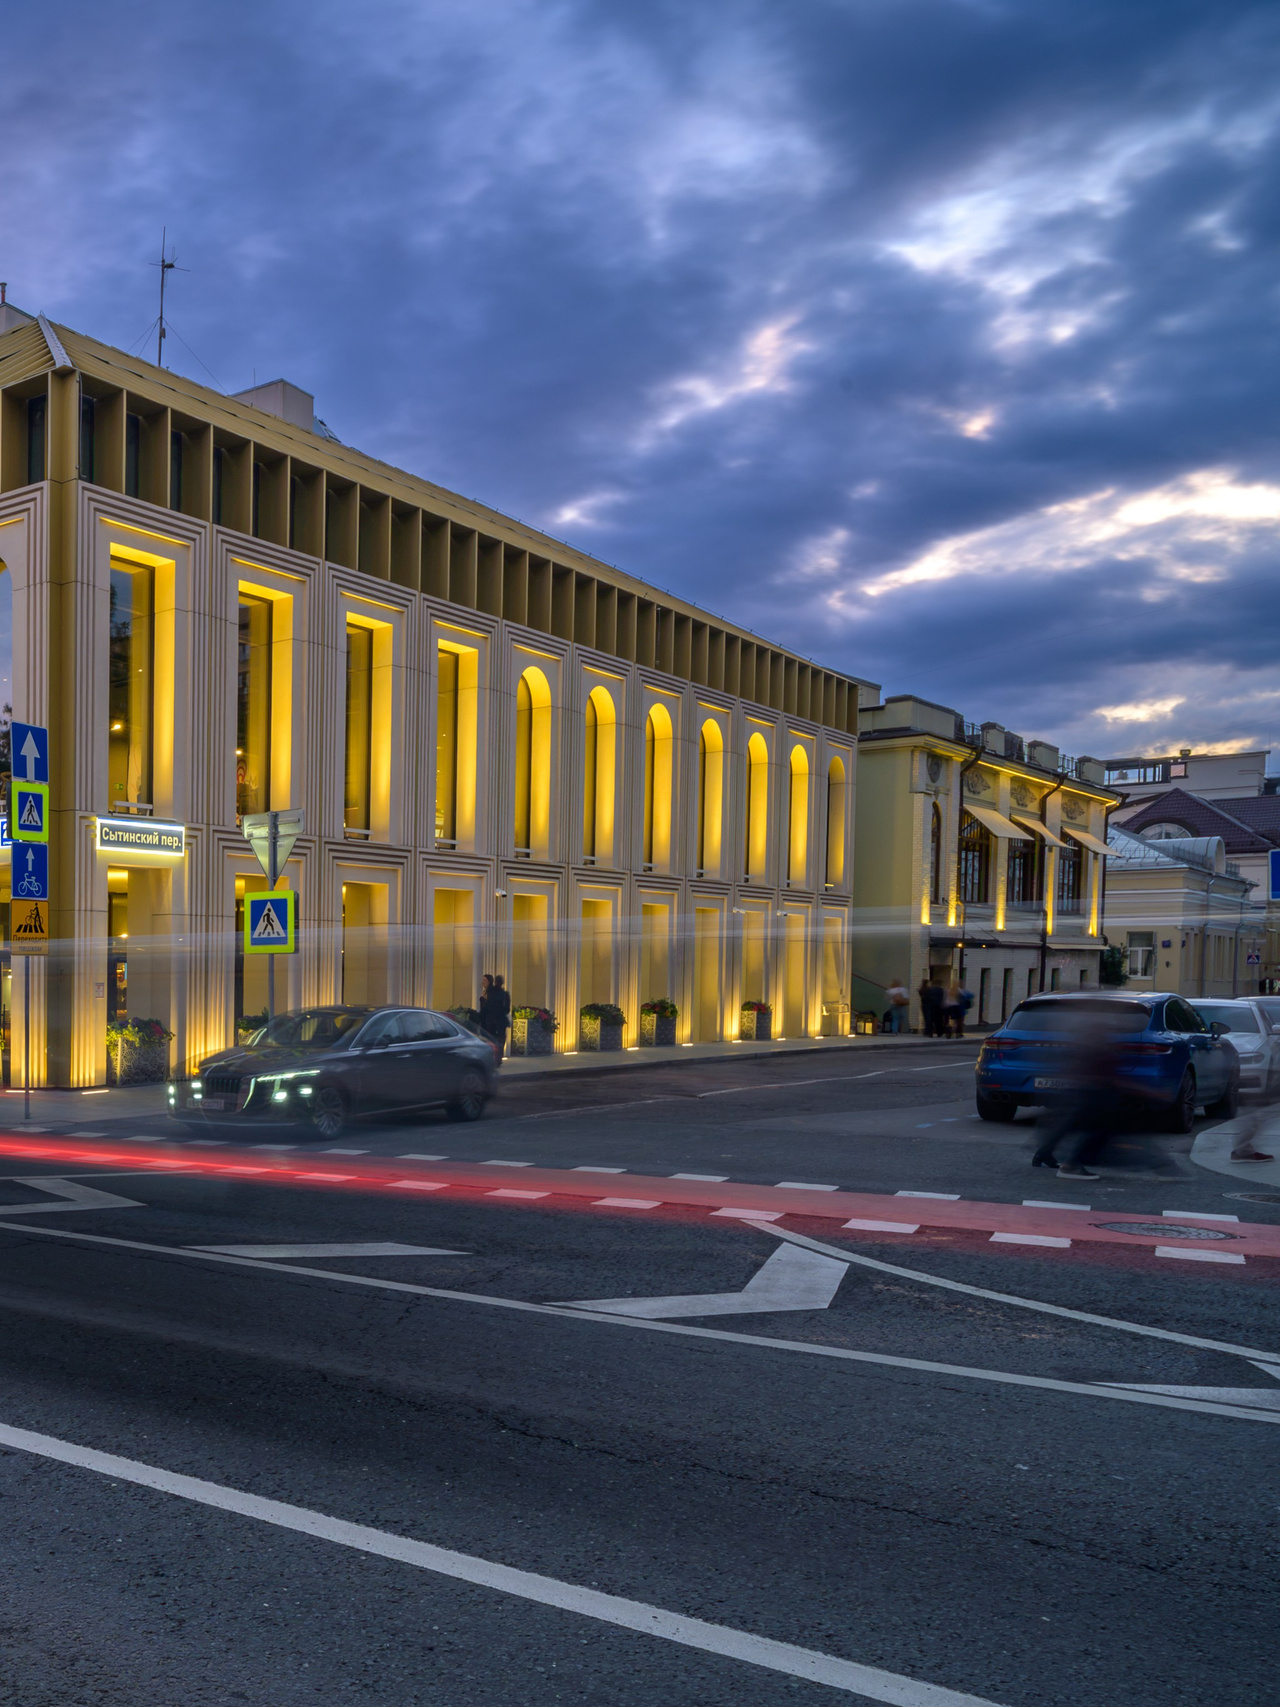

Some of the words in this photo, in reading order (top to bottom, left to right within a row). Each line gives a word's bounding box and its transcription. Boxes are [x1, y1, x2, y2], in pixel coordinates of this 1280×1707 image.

[102, 827, 159, 845] Сытинский
[161, 835, 181, 849] пер.
[13, 935, 48, 944] Переходите
